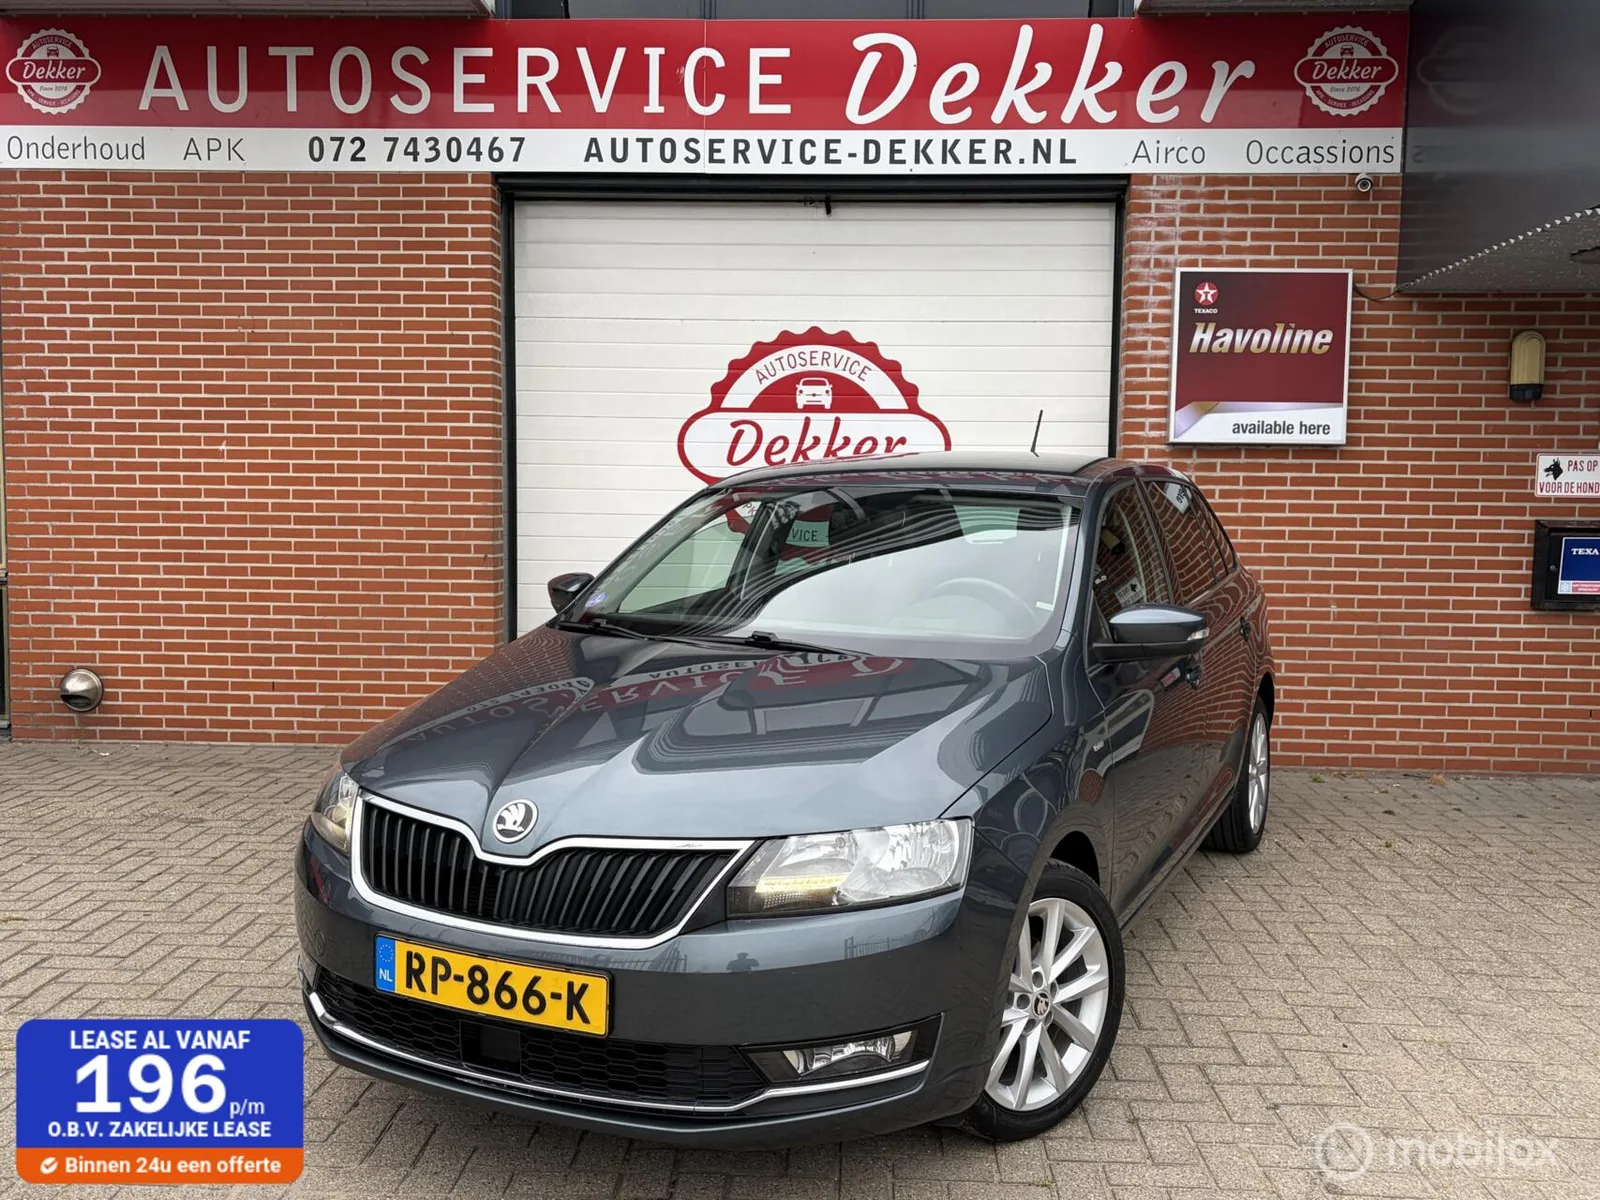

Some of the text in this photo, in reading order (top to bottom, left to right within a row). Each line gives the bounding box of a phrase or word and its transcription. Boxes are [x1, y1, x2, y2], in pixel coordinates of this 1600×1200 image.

[32, 36, 72, 49] AUTOSERVICE
[1324, 34, 1369, 48] AUTOSERVICE
[23, 60, 86, 79] Dekker
[138, 24, 1256, 125] AUTOSERVICE Dekker
[1312, 60, 1382, 80] Dekker
[7, 135, 246, 162] Onderhoud APK
[308, 136, 526, 163] 072 7430467
[584, 136, 1077, 165] AUTOSERVICE-DEKKER.NL
[1132, 138, 1395, 165] Airco Occassions
[1189, 322, 1333, 355] Havoline
[755, 350, 871, 385] AUTOSERVICE
[1232, 421, 1331, 435] available here
[1567, 460, 1598, 472] PAS OP
[1539, 481, 1600, 494] VOOR DE HOND
[379, 967, 393, 982] NL
[406, 950, 590, 1025] RP-866-K
